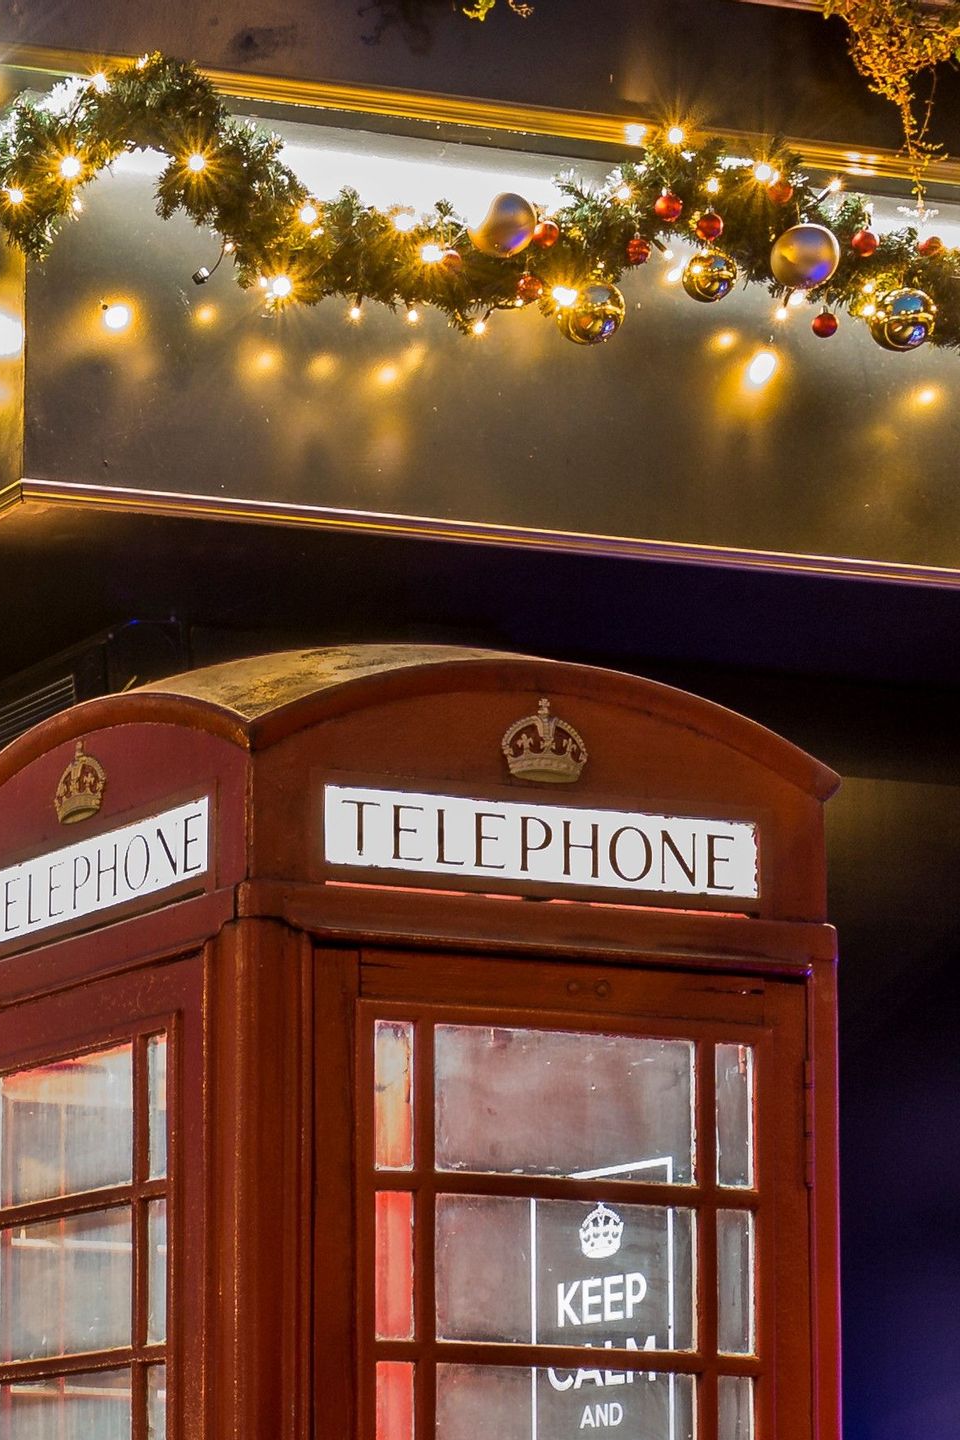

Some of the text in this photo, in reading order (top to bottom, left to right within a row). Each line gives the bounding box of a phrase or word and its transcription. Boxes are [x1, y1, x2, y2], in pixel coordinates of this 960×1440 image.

[340, 799, 736, 891] TELEPHONE
[556, 1272, 648, 1328] KEEP
[579, 1402, 624, 1430] AND
